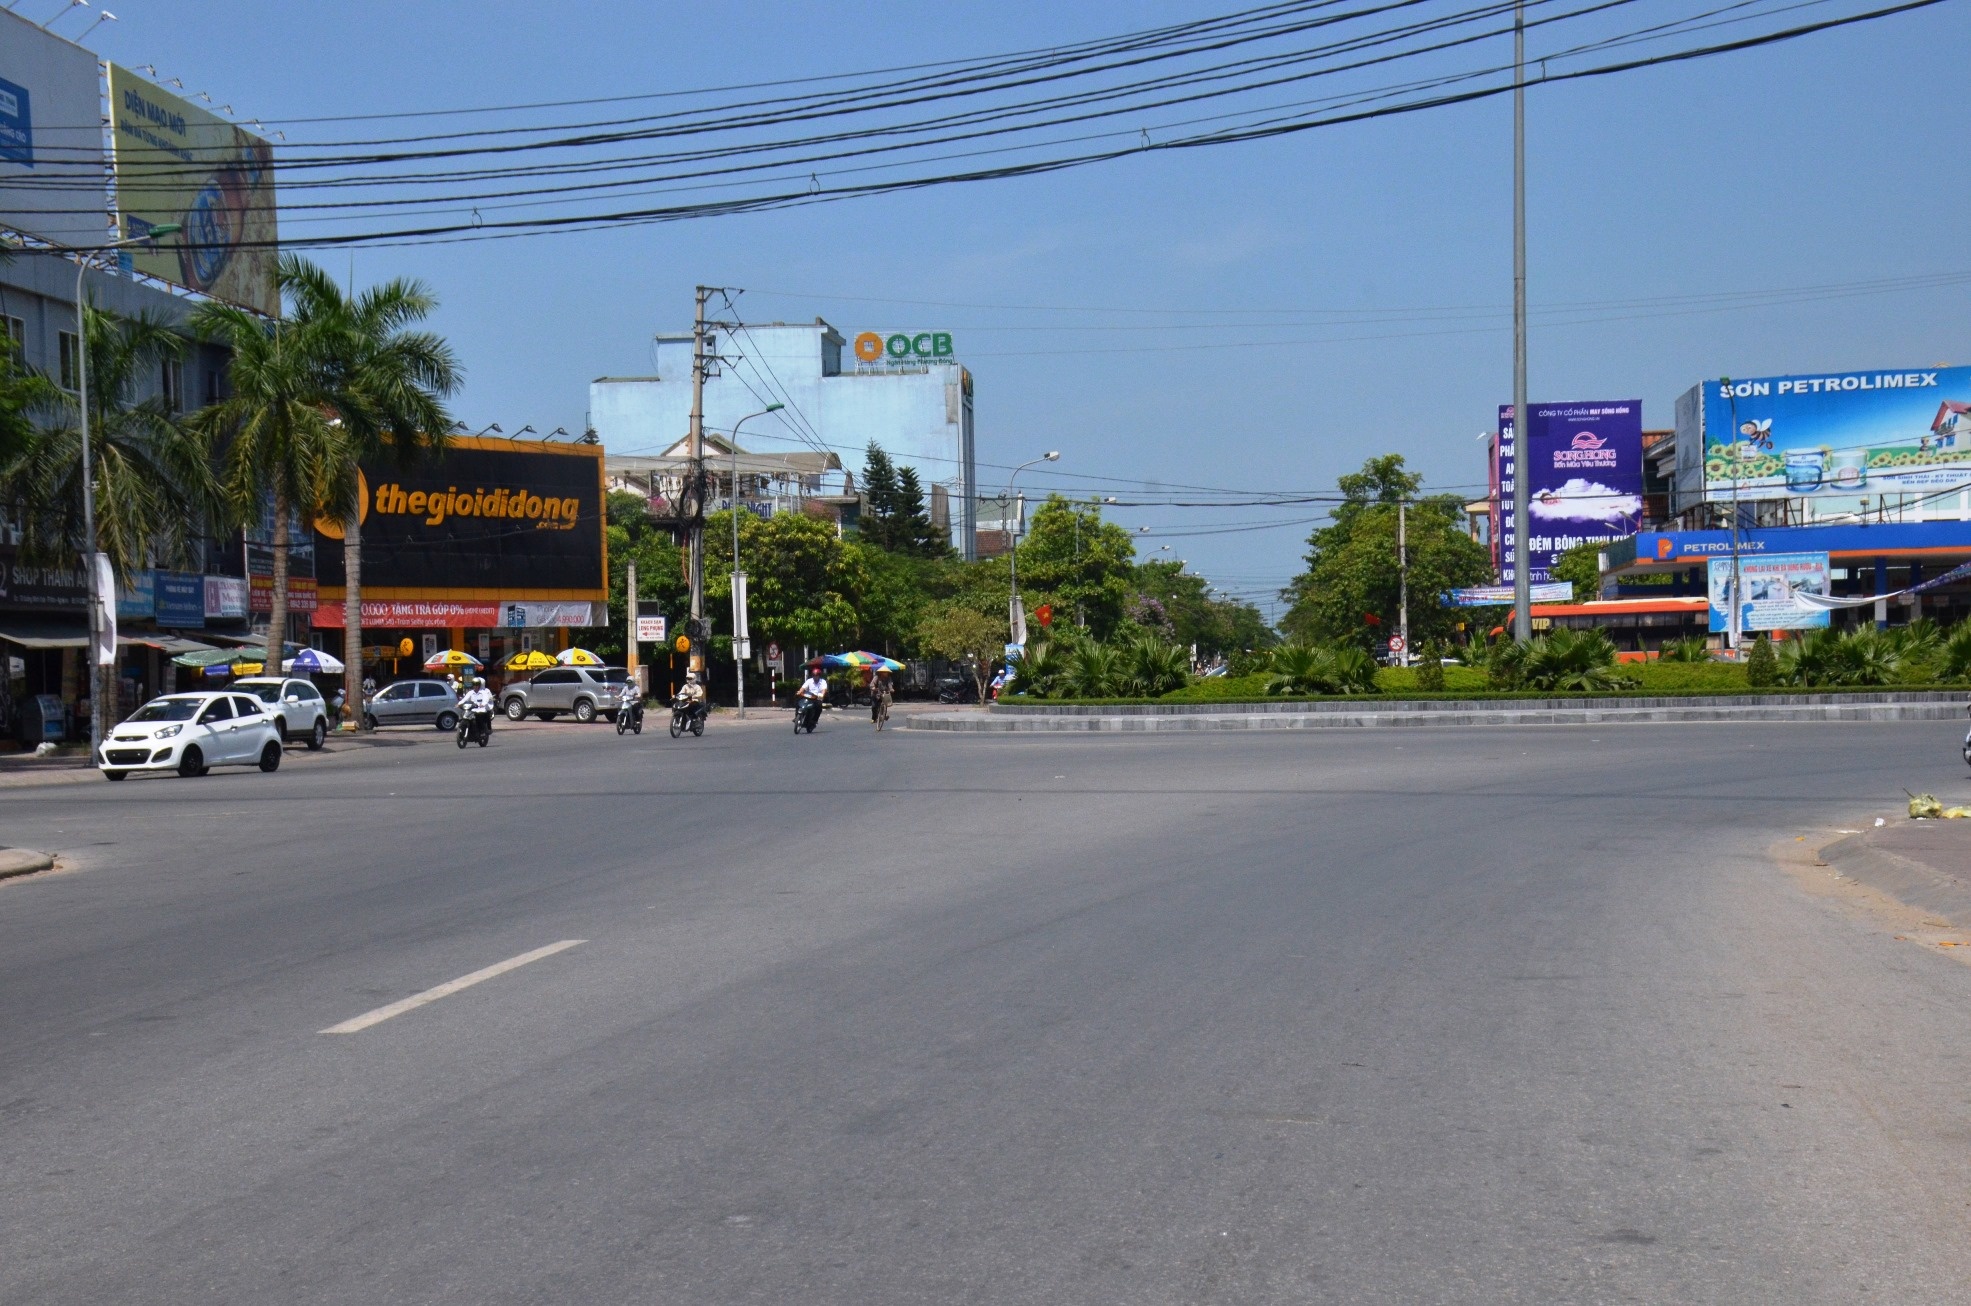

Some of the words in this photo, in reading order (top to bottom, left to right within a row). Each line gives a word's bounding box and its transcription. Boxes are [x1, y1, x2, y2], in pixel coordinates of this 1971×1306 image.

[886, 333, 952, 357] OCB
[1719, 380, 1770, 399] SƠN
[1778, 372, 1938, 396] PETROLIMEX
[1538, 407, 1557, 417] CÔNG
[1601, 407, 1615, 415] SÔNG
[376, 483, 580, 530] thegioididong
[1529, 535, 1552, 554] ĐỆM
[1554, 534, 1583, 551] BÔNG
[1683, 540, 1765, 552] PETROLMEX
[12, 566, 39, 586] SHOP
[414, 600, 432, 615] TRẢ
[432, 602, 450, 615] GÓP
[450, 604, 464, 615] 0%
[1532, 618, 1551, 630] VIP
